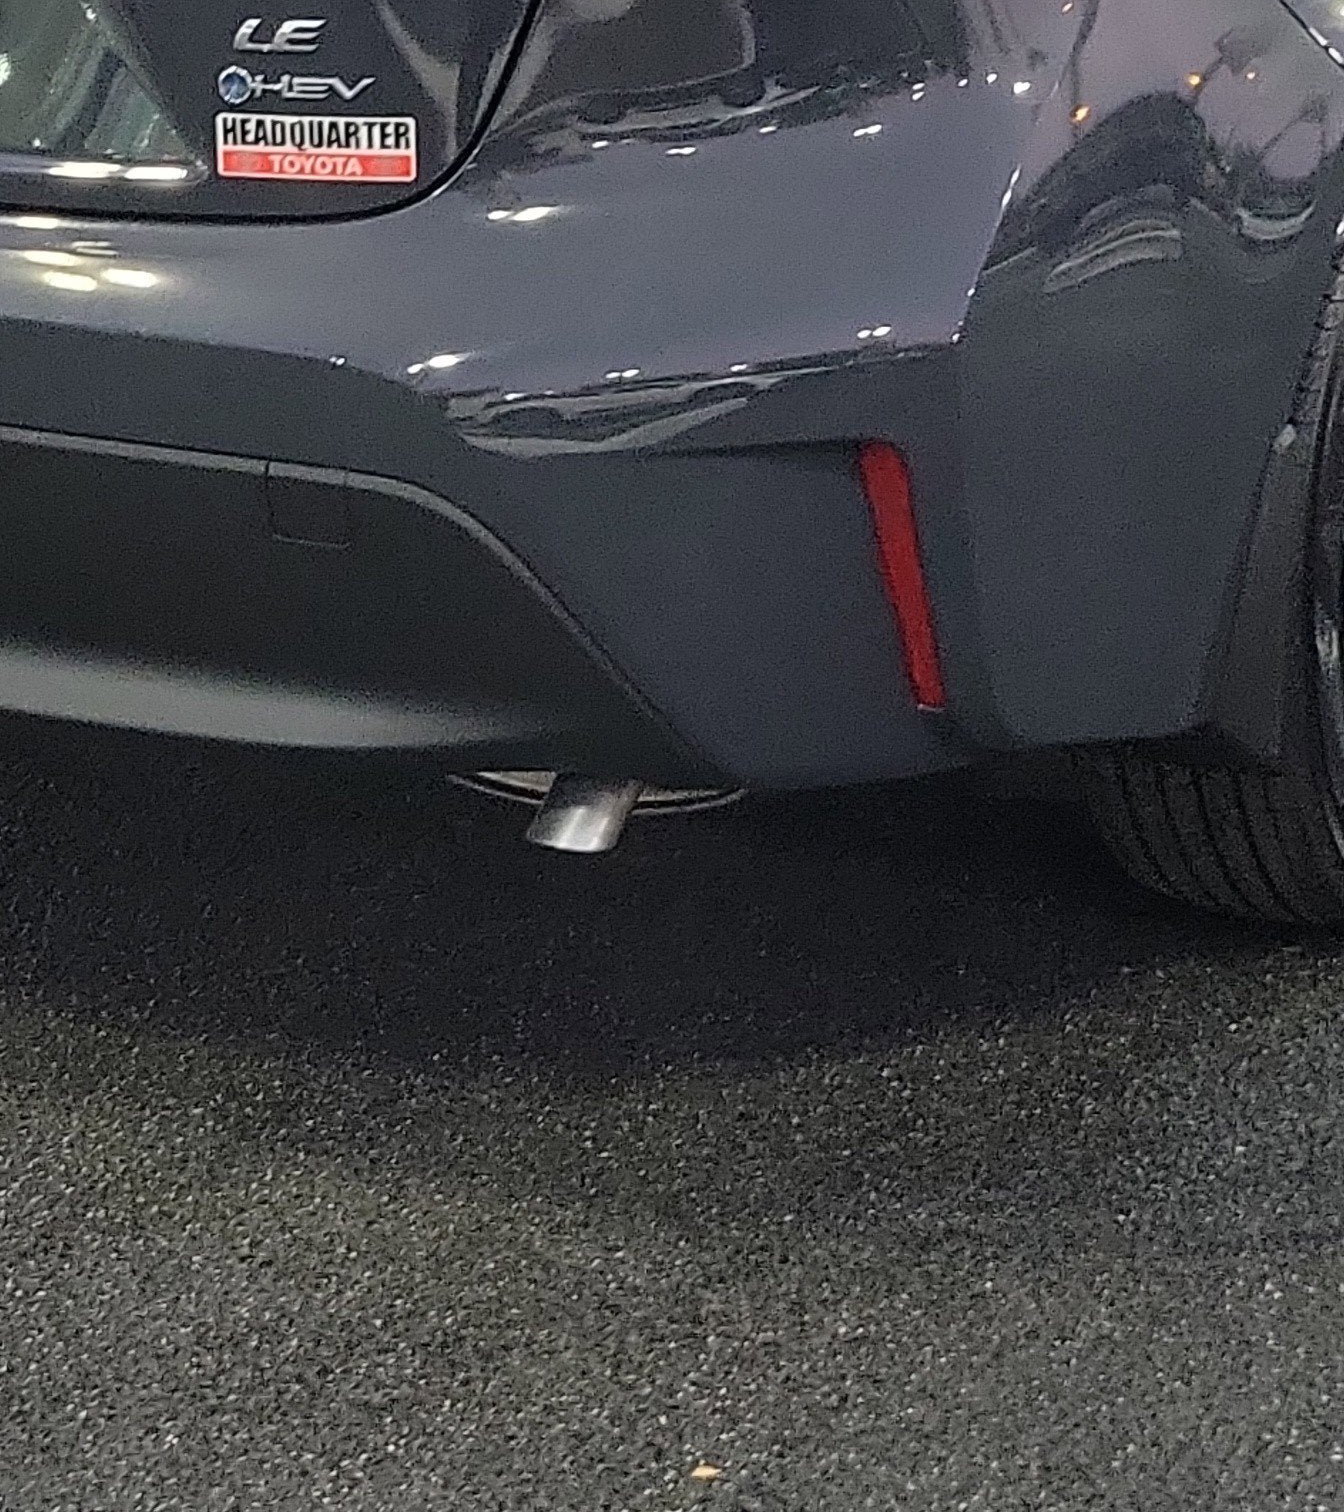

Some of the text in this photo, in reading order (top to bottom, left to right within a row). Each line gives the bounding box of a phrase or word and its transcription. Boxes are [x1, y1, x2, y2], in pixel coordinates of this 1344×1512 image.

[232, 18, 327, 52] LE
[252, 74, 377, 100] HEV
[221, 116, 411, 150] HEADQUARTER
[267, 154, 363, 176] TOYOTA
